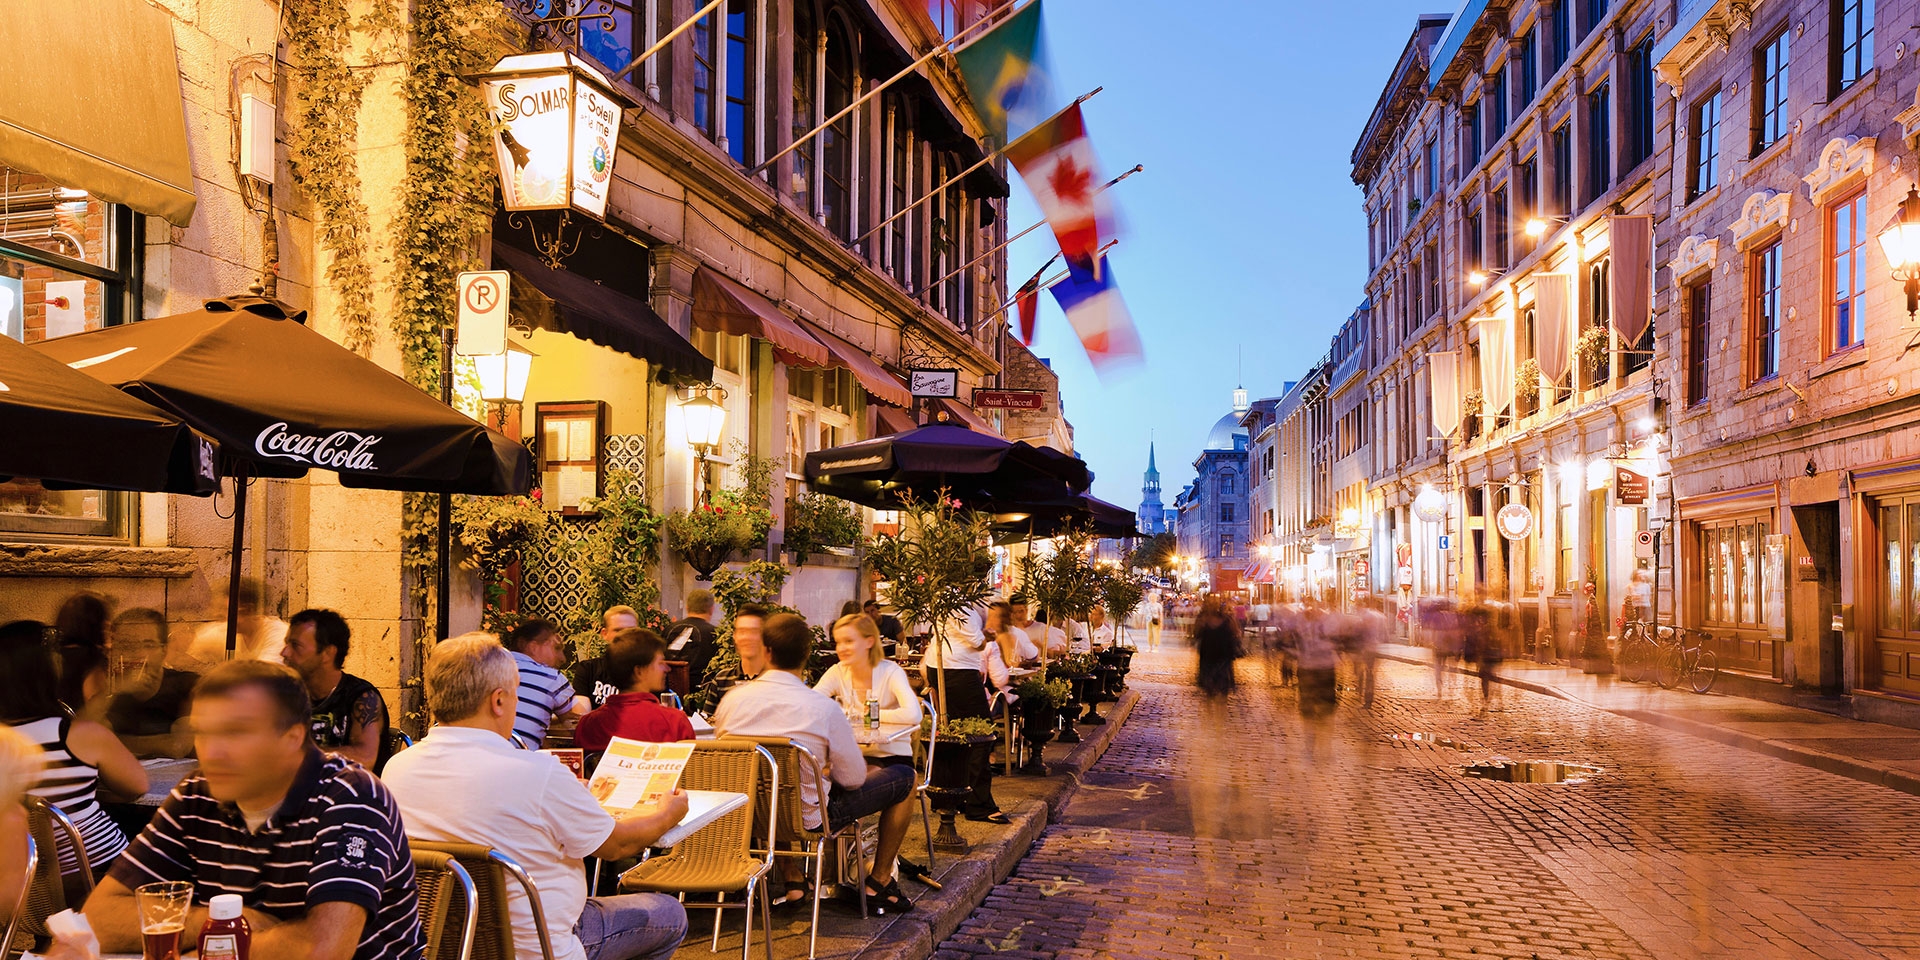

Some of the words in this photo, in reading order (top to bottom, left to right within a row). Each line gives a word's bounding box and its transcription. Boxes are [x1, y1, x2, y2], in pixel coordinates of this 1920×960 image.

[499, 84, 569, 121] SOLMAR
[588, 93, 614, 125] Soleil
[984, 397, 1033, 407] Saint-Vincent
[255, 422, 383, 470] Coca-Cola
[1800, 557, 1813, 565] 114
[618, 759, 633, 769] La
[637, 761, 683, 771] Gazette
